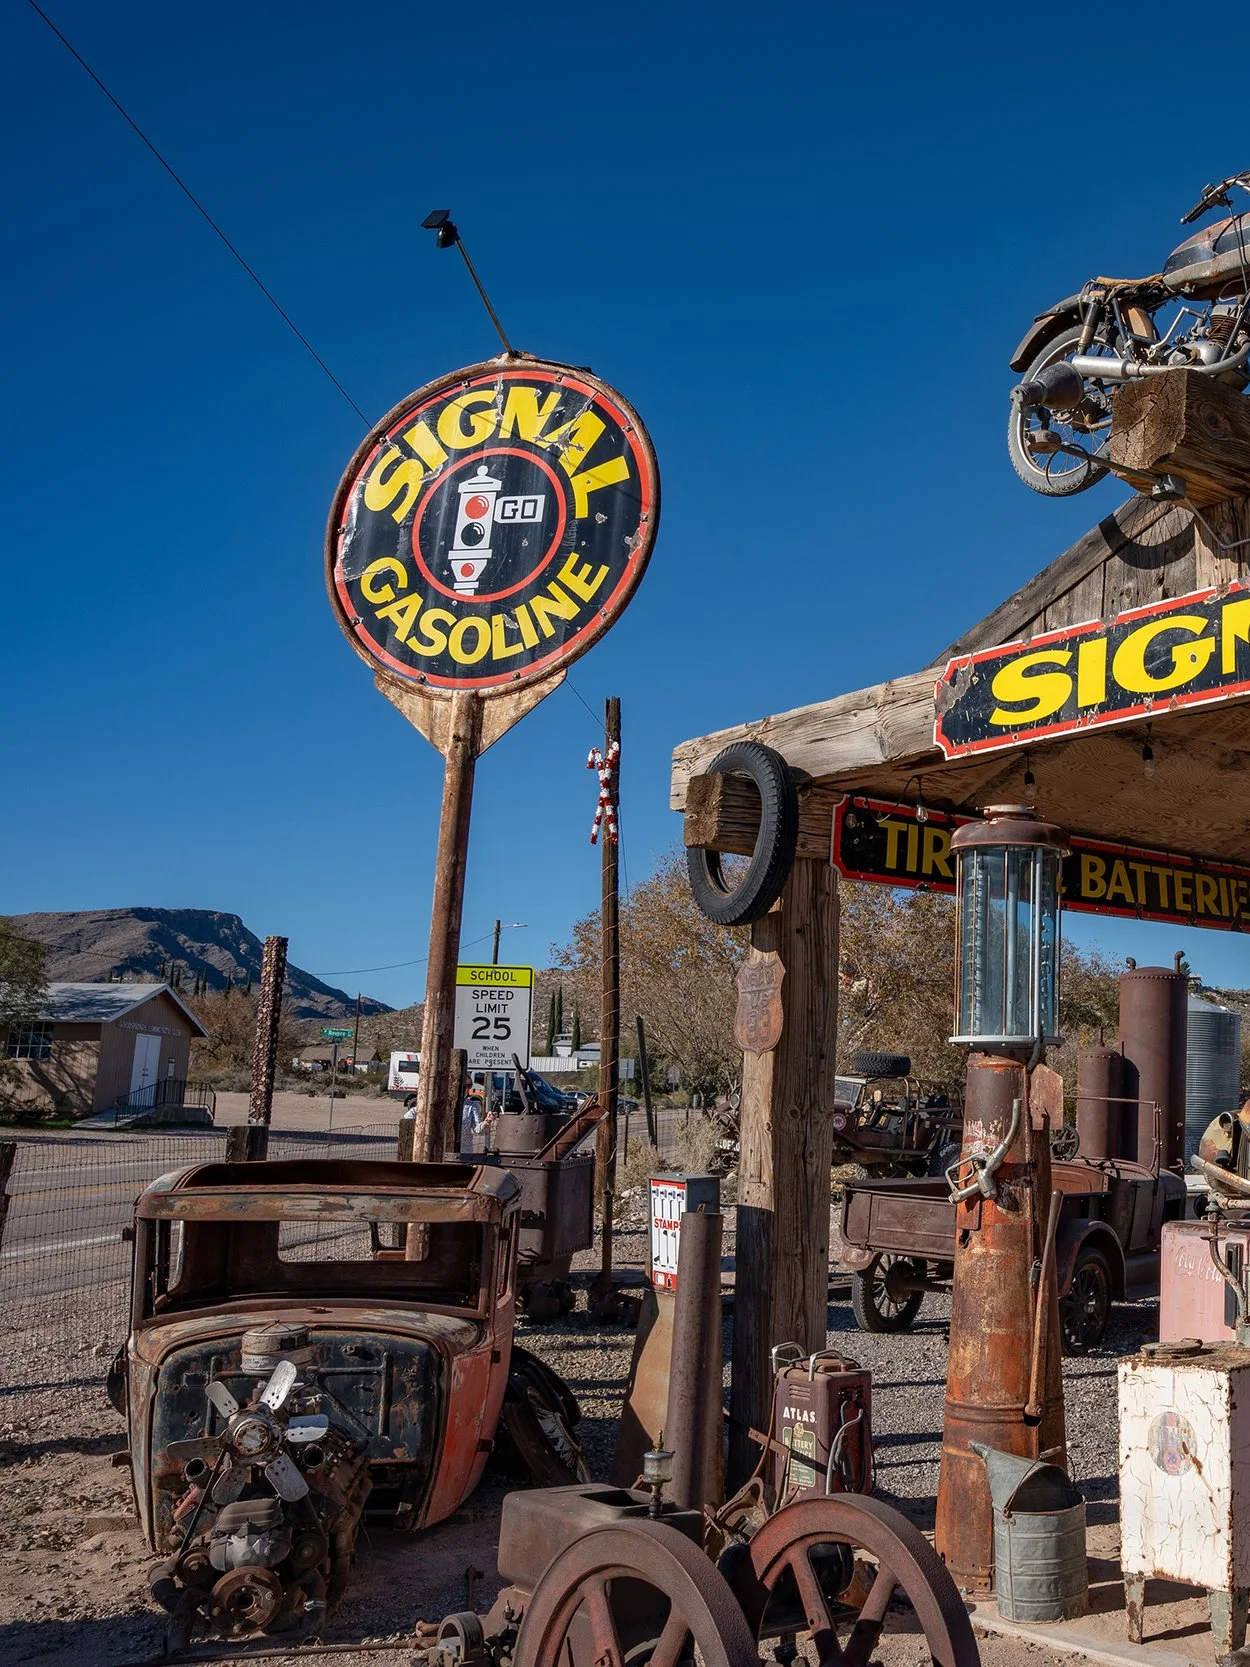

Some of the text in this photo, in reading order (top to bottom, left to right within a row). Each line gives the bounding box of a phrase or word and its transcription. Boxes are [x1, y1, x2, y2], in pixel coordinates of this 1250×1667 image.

[364, 386, 630, 520] SIGNAL
[501, 499, 538, 519] GO
[360, 552, 609, 664] GASOLINE
[470, 970, 517, 982] SCHOOL
[471, 989, 515, 1001] SPEED
[475, 1003, 509, 1014] LIMIT
[471, 1016, 512, 1041] 25
[783, 1406, 816, 1423] ATLAS
[784, 1437, 813, 1450] BTTERY
